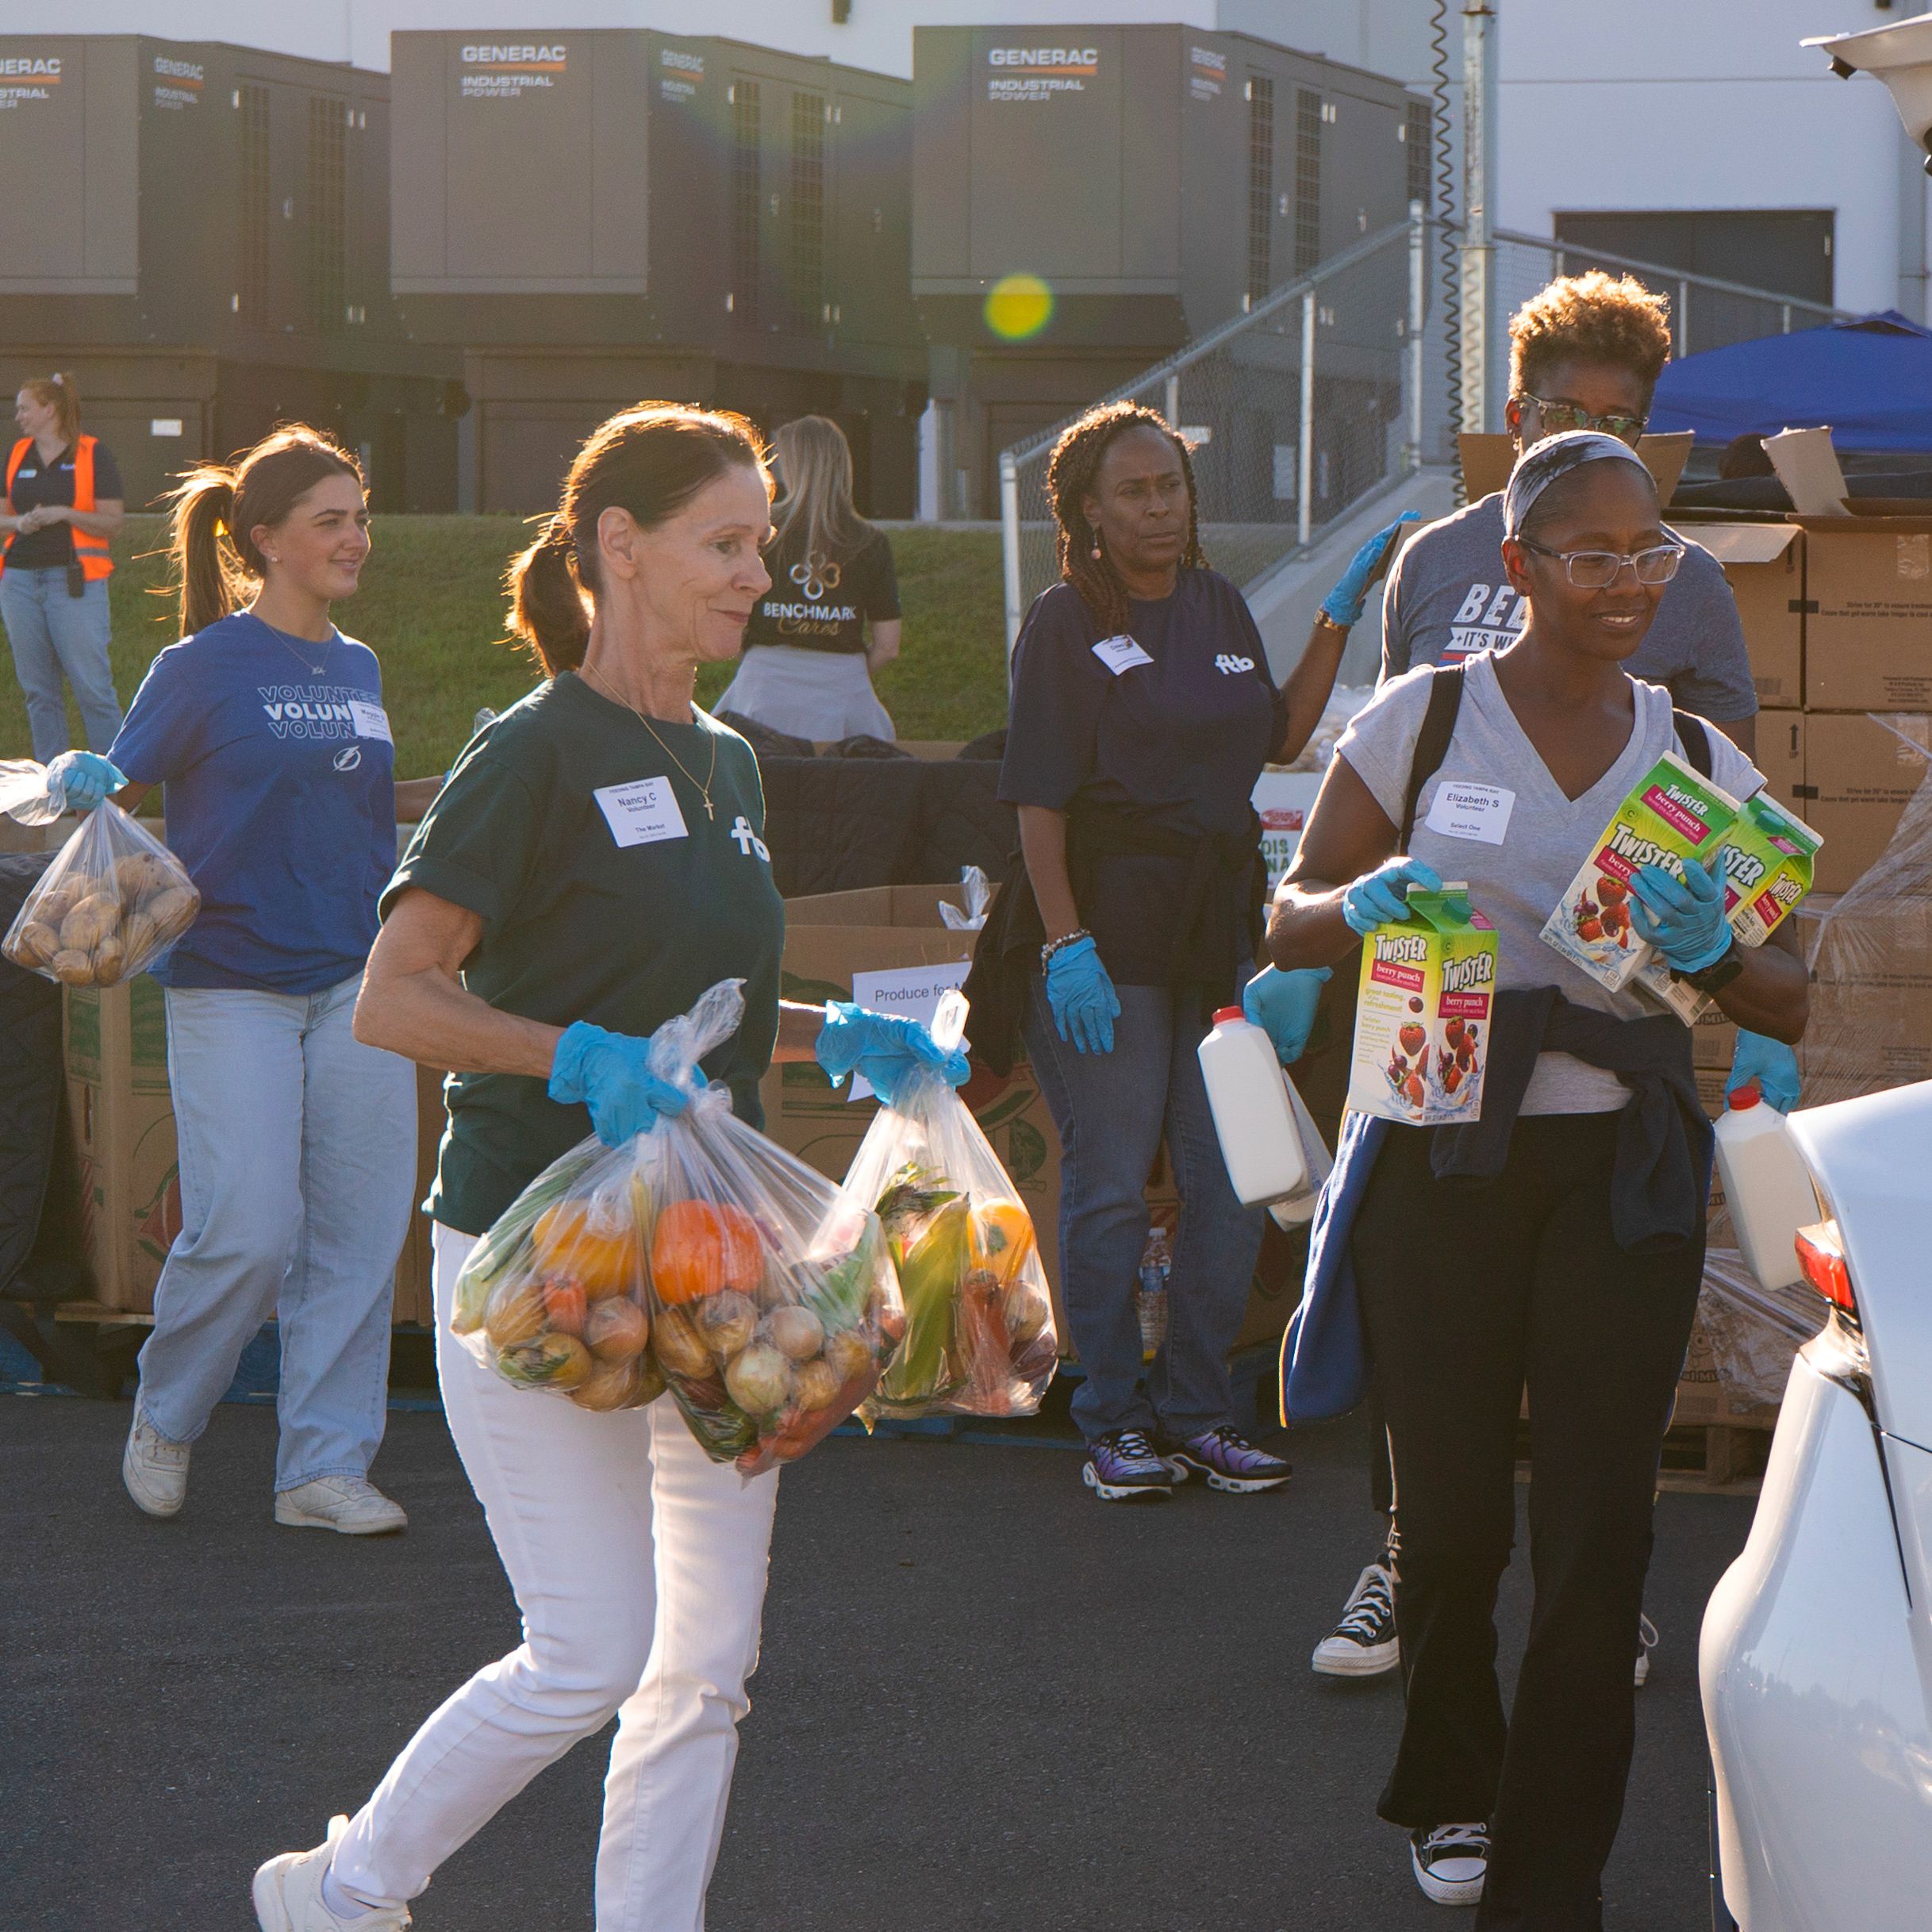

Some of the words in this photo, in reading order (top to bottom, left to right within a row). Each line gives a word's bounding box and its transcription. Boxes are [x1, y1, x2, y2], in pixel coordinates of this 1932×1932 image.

[462, 45, 567, 63] GENERAC
[989, 48, 1098, 66] GENERAC
[0, 58, 61, 75] ERAC
[153, 56, 204, 80] GENERAC
[462, 75, 554, 87] INDUSTRIAL
[989, 79, 1085, 90] INDUSTRIAL
[462, 86, 521, 97] POWER
[989, 90, 1051, 102] POWER
[763, 602, 856, 621] BENCHMARK
[778, 616, 841, 636] Cares
[1463, 632, 1489, 647] IT'S
[257, 685, 381, 704] VOLUNTEE
[263, 702, 352, 720] VOLUN
[267, 720, 359, 739] VOLUN
[617, 795, 647, 807] Nancy
[648, 792, 657, 801] C
[627, 804, 655, 812] Volunteer
[1446, 793, 1489, 806] Elizabeth
[1492, 799, 1500, 808] S
[1455, 803, 1485, 812] Volunteer
[1655, 793, 1677, 812] berry
[1675, 809, 1701, 832] punch
[1608, 855, 1633, 876] berry
[1376, 963, 1396, 979] berry
[1397, 970, 1421, 982] punch
[874, 987, 929, 1003] Produce
[1446, 997, 1463, 1008] berry
[1463, 997, 1483, 1008] punch
